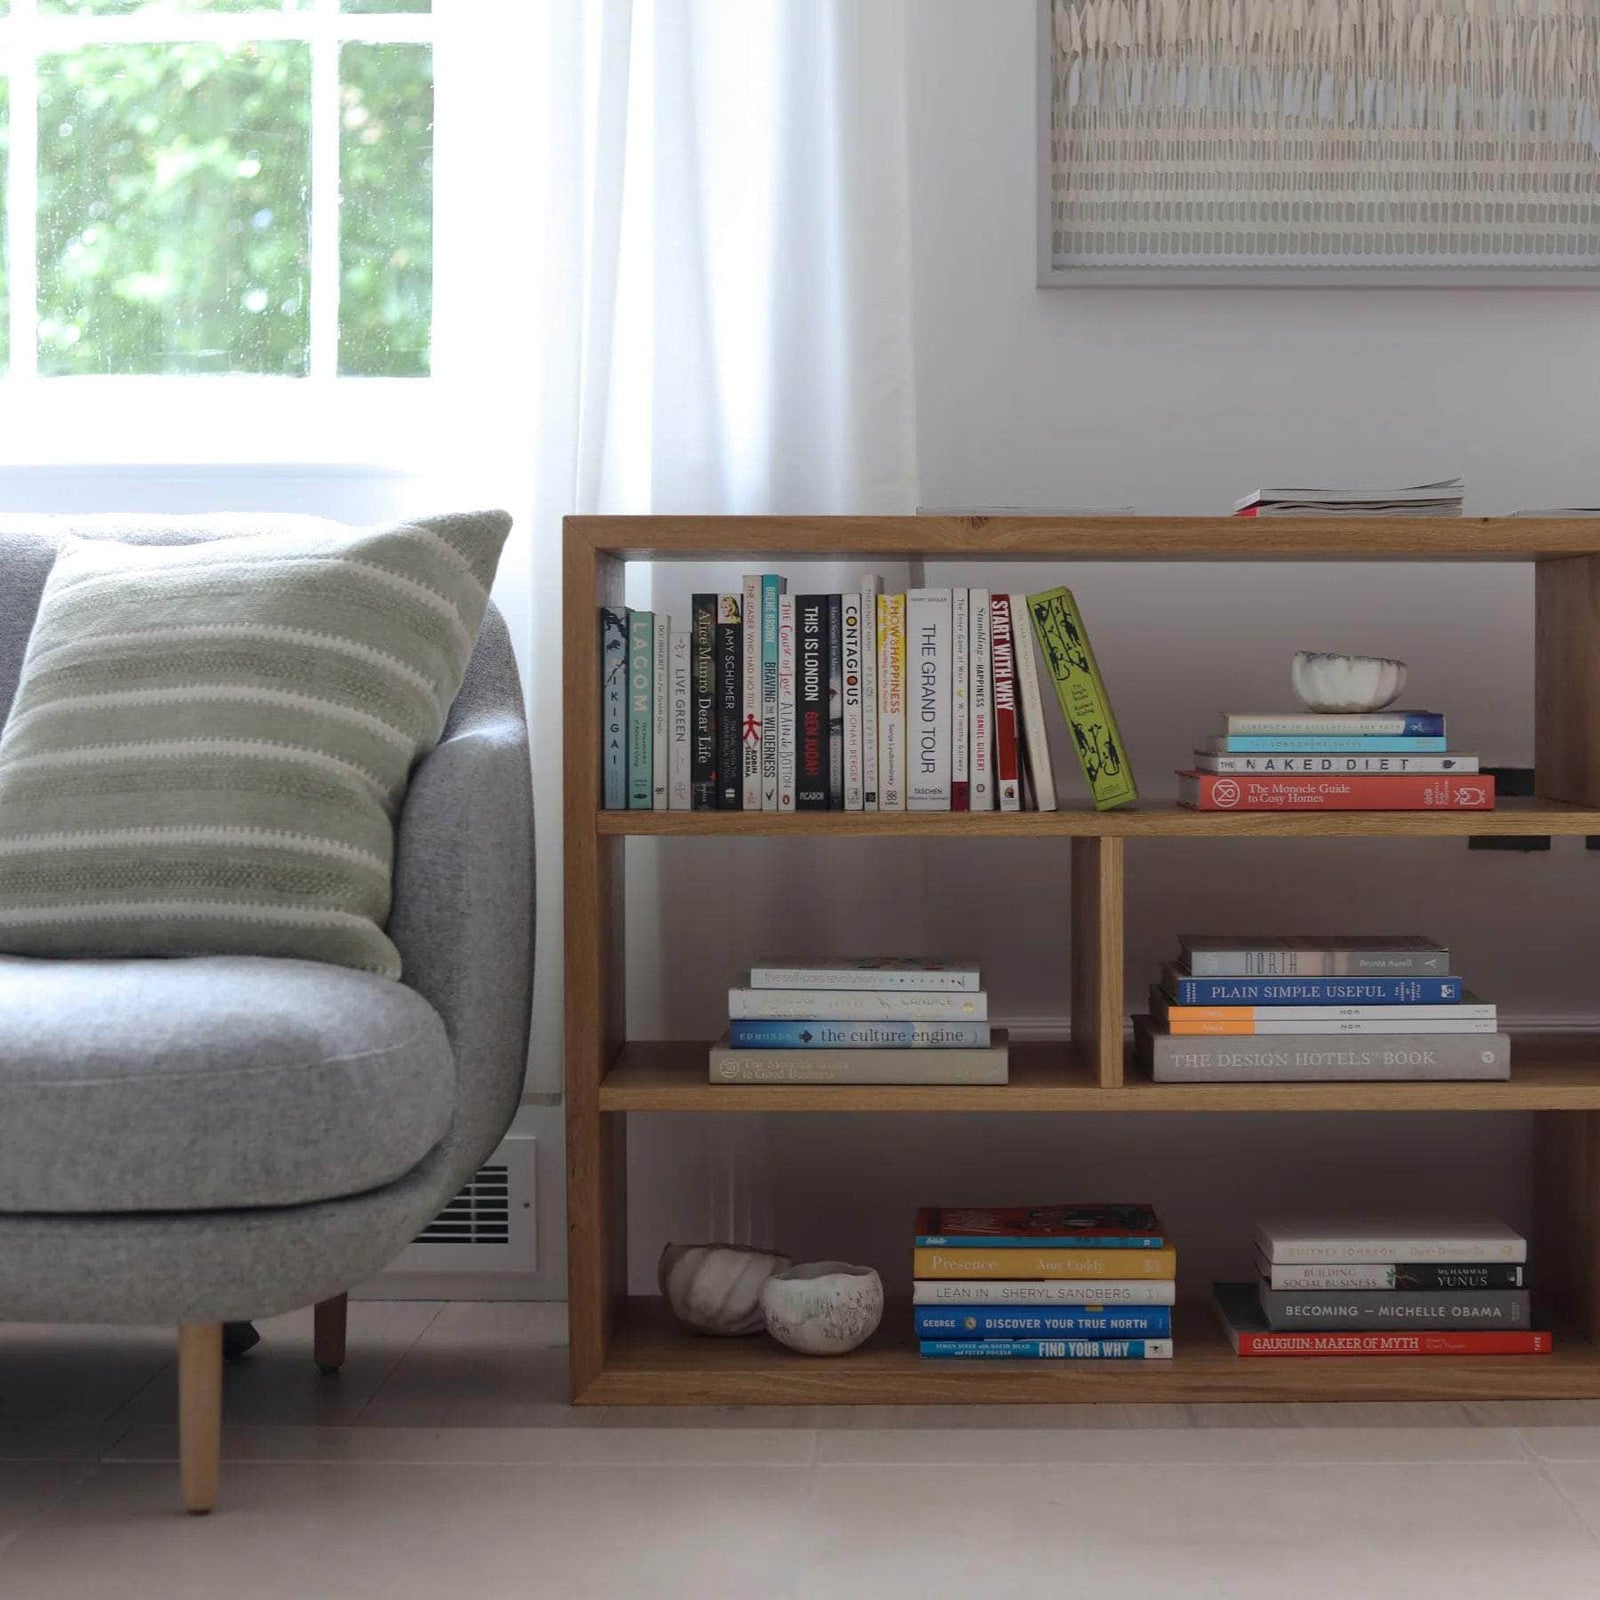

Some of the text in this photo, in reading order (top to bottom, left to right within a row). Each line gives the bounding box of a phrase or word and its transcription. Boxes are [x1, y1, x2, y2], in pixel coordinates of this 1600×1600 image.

[746, 602, 755, 629] LEADER
[765, 614, 776, 643] BROWN
[890, 606, 899, 637] HOW
[724, 628, 735, 653] AMY
[746, 631, 755, 654] WHO
[632, 622, 649, 712] LAGOM
[746, 656, 755, 673] HAD
[845, 606, 858, 706] CONTAGIOUS
[992, 600, 1014, 711] START WITH WHY
[675, 669, 687, 696] LIVE
[698, 609, 712, 764] Alice Munro Dear Life
[724, 655, 735, 709] SCHUMER
[746, 676, 755, 690] NO
[765, 661, 776, 703] BRAVING
[804, 606, 818, 776] THIS IS LONDON BEN JUDAH
[890, 646, 899, 714] HAPPINESS
[975, 607, 986, 772] Stumbling HAPPINESS DANIEL GILBERT
[921, 624, 936, 774] THE GRAND TOUR
[610, 676, 619, 765] IKIGAI
[675, 699, 687, 742] GREEN
[848, 714, 857, 747] JONAH
[765, 716, 776, 778] WILDERNESS
[849, 749, 857, 783] BERGER
[1220, 758, 1409, 770] THE NAKED DIET
[1248, 784, 1351, 793] The Monocle Guide
[1248, 793, 1324, 804] to Cosy Homes
[1211, 986, 1260, 998] PLAIN
[1264, 986, 1321, 998] SIMPLE
[1326, 986, 1386, 998] USEFUL
[820, 1029, 845, 1042] the
[850, 1029, 907, 1042] culture
[911, 1030, 964, 1043] engine
[1170, 1054, 1211, 1068] THE
[1218, 1053, 1292, 1067] DESIGN
[1384, 1051, 1436, 1065] BOOK
[932, 1256, 997, 1272] Presence
[1037, 1259, 1066, 1273] Amy
[1304, 1269, 1357, 1277] BUILDING
[936, 1288, 1131, 1299] LEAN IN SHERYL SANDBERG
[1283, 1279, 1378, 1288] SOCIAL BUSINESS
[1438, 1276, 1488, 1286] YUNUS
[922, 1319, 956, 1328] GEORGE
[985, 1319, 1041, 1329] DISCOVER
[1045, 1319, 1073, 1329] YOUR
[1077, 1319, 1107, 1329] TRUE
[1110, 1319, 1148, 1329] NORTH
[1285, 1305, 1358, 1317] BECOMING
[1378, 1305, 1446, 1317] MICHELLE
[1452, 1306, 1502, 1318] OBAMA
[1038, 1342, 1130, 1357] FIND YOUR WHY
[1252, 1338, 1314, 1350] GAUGUIN:
[1314, 1338, 1362, 1350] MAKER
[1363, 1338, 1380, 1349] OF
[1381, 1337, 1419, 1349] MYTH
